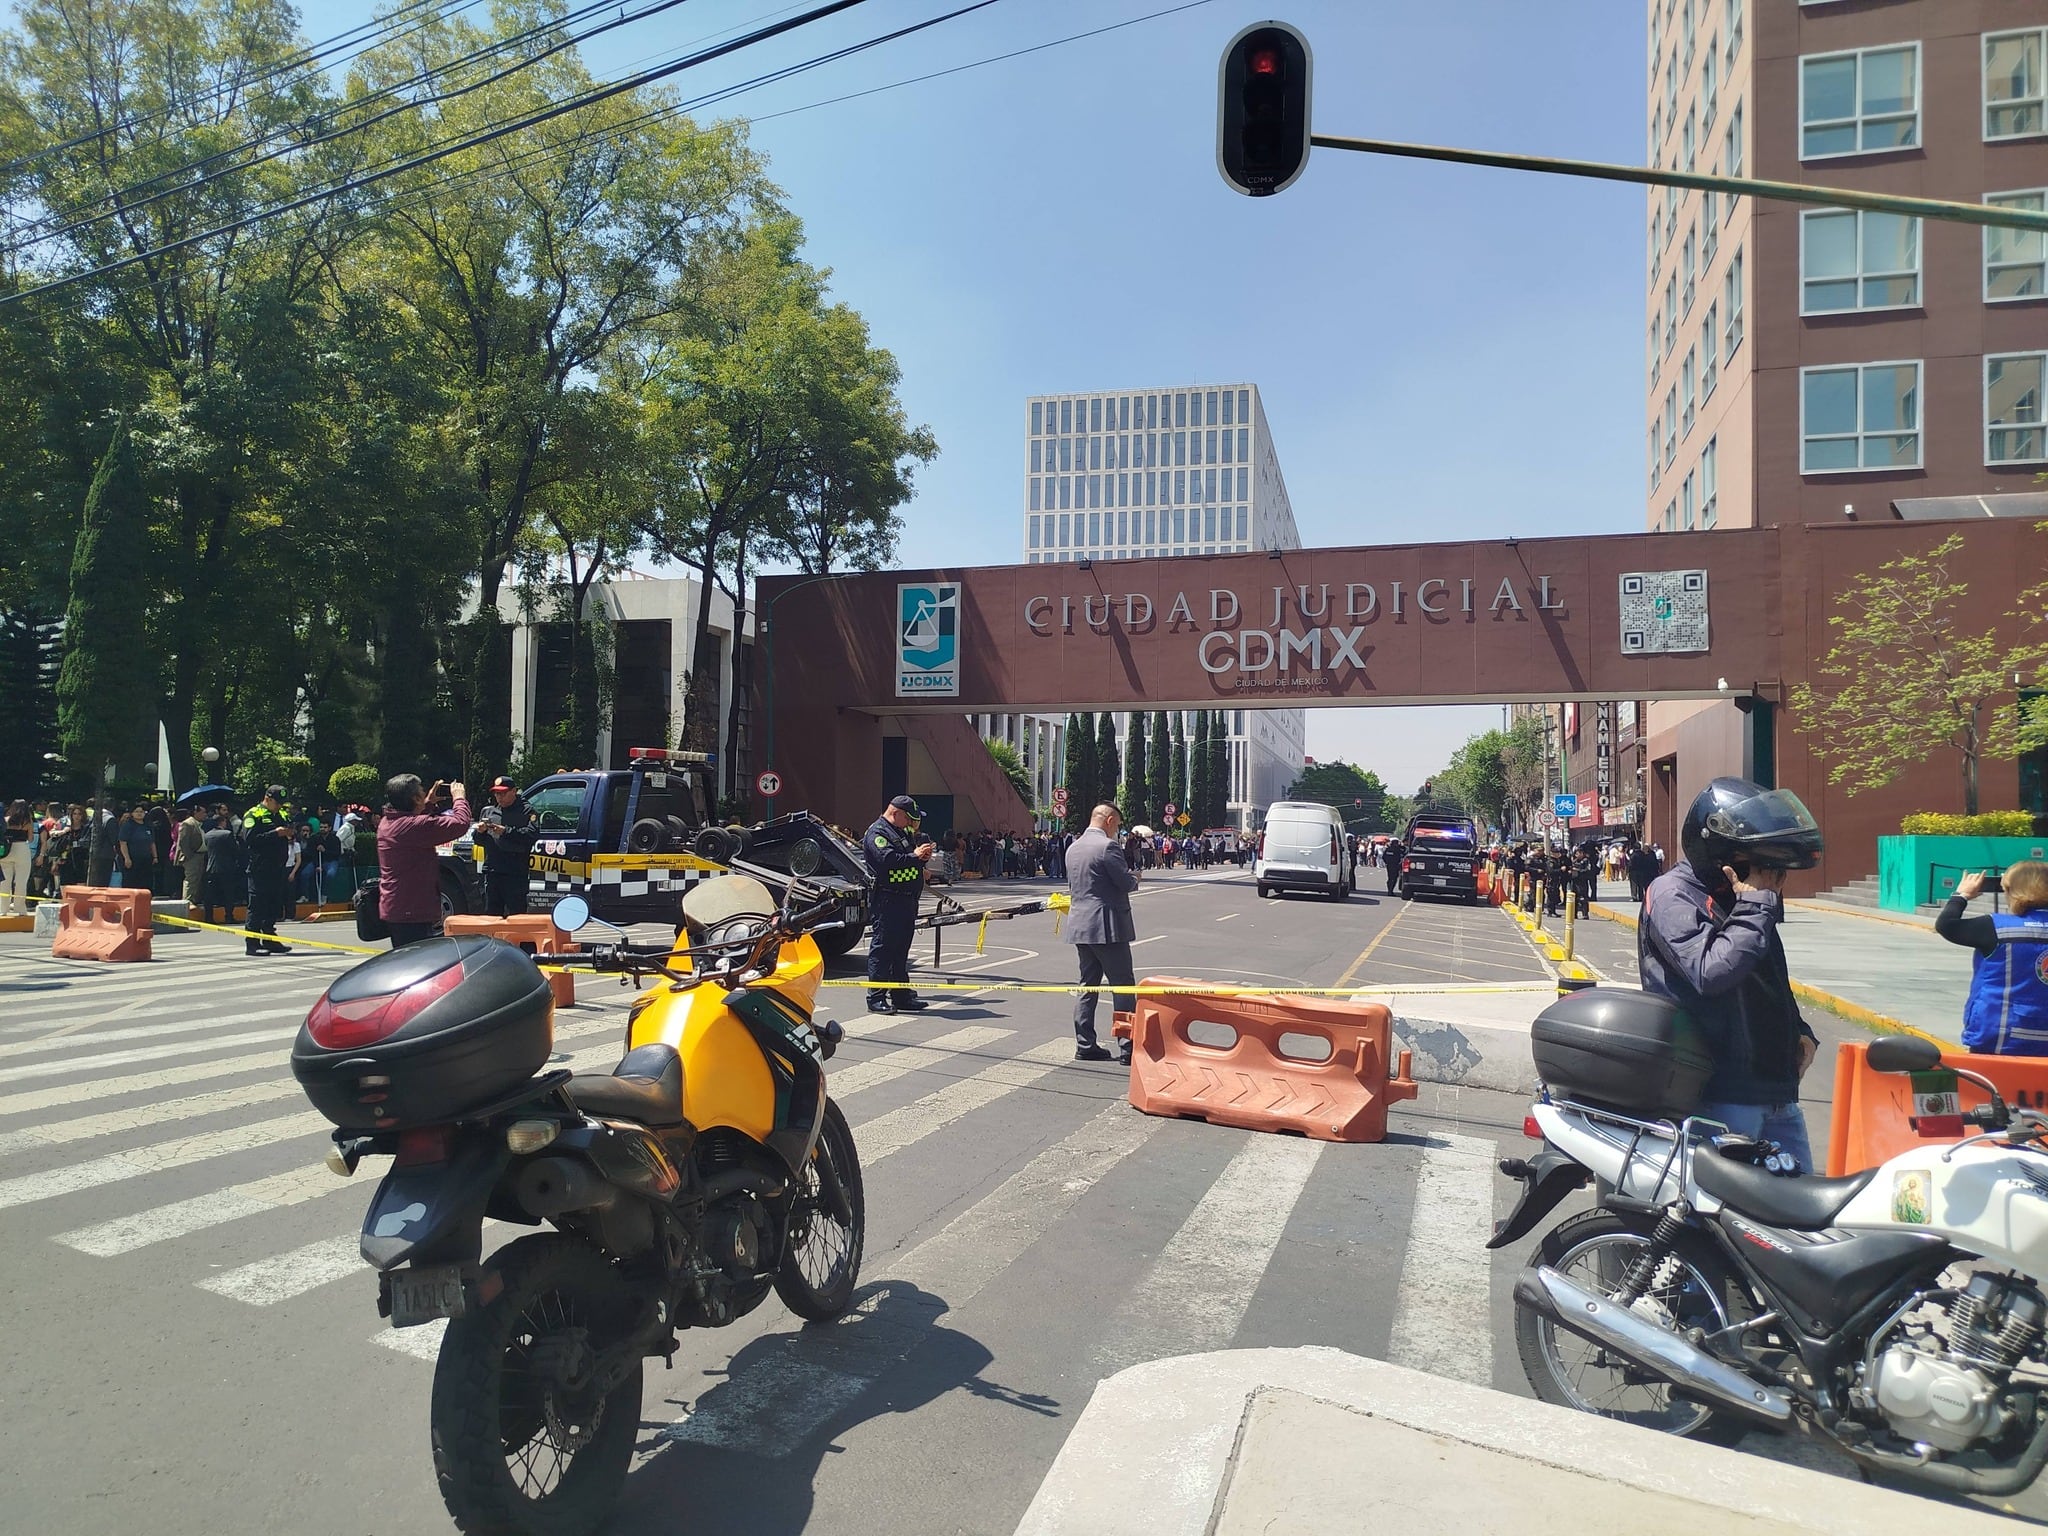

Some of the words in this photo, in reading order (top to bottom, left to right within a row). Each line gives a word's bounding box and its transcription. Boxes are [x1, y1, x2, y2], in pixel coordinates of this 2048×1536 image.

[1247, 176, 1274, 184] CDMX
[1024, 589, 1239, 628] CIUDAD
[1269, 575, 1565, 628] JUDICIAL
[1198, 625, 1367, 673] CDMX
[901, 676, 954, 687] PJCDMX
[1235, 679, 1271, 688] CIUDAD
[1275, 678, 1288, 687] DE
[540, 857, 566, 873] VIAL
[1932, 1394, 1966, 1409] HONDA
